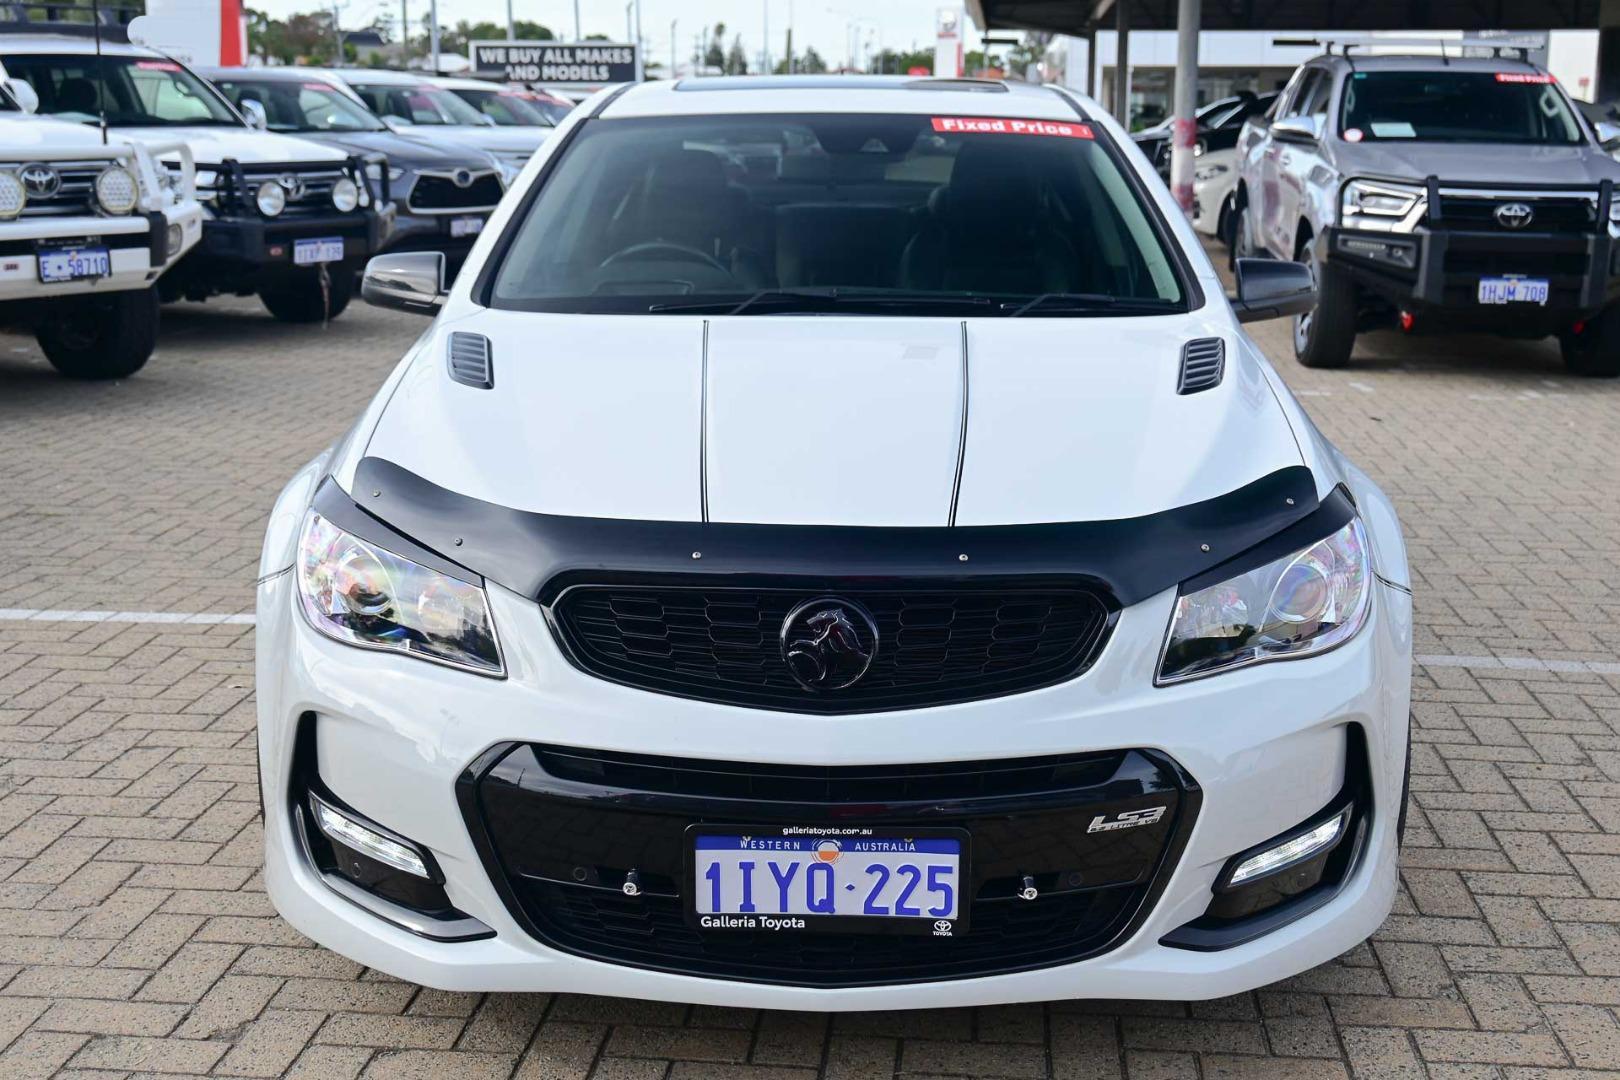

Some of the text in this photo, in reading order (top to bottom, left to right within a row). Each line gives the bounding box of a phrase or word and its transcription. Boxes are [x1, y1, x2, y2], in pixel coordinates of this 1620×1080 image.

[479, 48, 633, 64] WE BUY ALL MAKES
[541, 65, 609, 81] MODELS
[942, 118, 1073, 135] Fixed Price
[68, 258, 107, 276] 58710
[1482, 285, 1546, 300] 1HJM 708
[1087, 806, 1166, 830] LS3
[782, 827, 872, 835] galleriatoyota.com.au
[740, 840, 916, 852] WESTERN AUSTRALIA
[700, 916, 805, 931] Galleria Toyota
